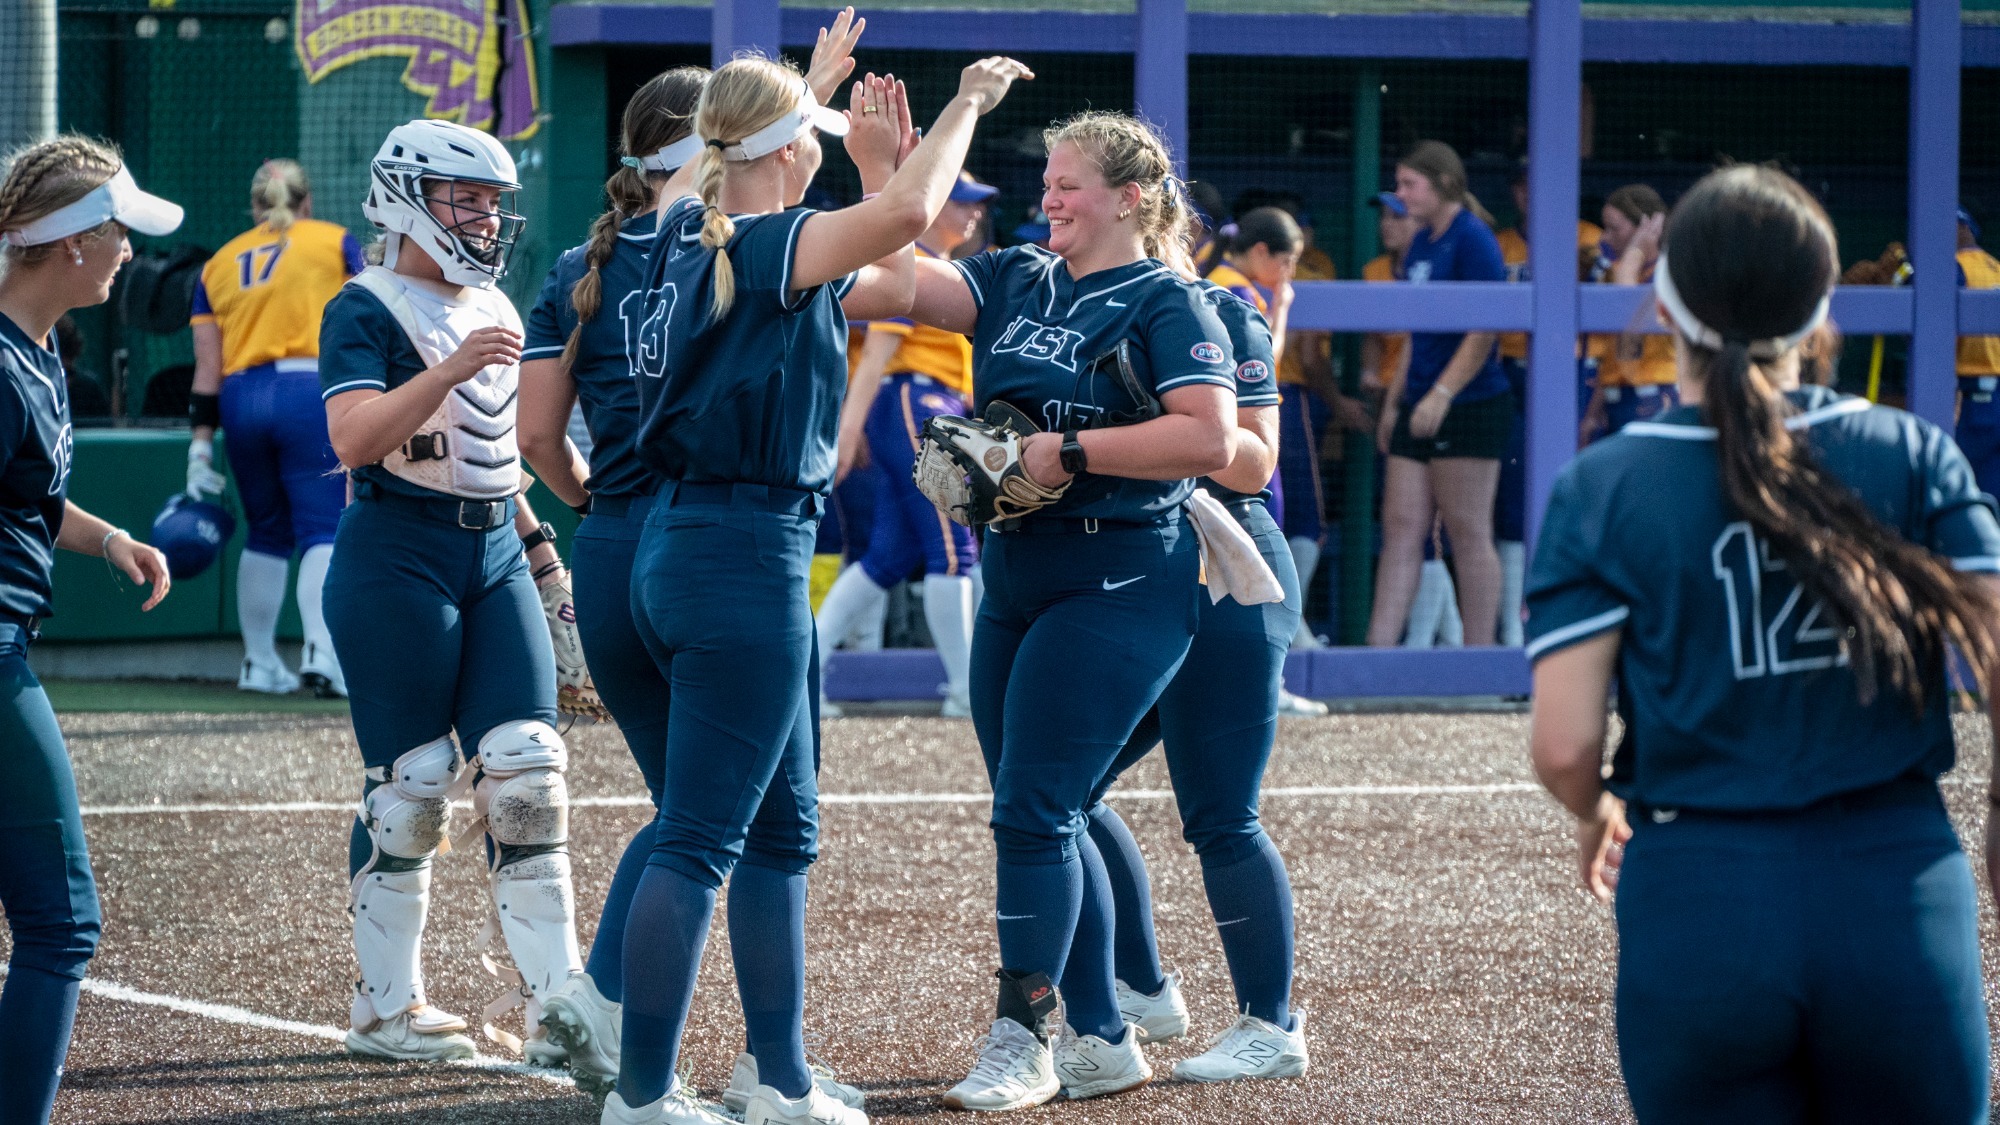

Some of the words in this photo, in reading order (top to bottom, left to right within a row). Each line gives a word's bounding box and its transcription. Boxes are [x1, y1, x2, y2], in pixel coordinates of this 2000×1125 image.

[234, 239, 291, 291] 17
[991, 315, 1086, 373] USI
[1197, 346, 1220, 359] OVC
[1243, 366, 1264, 377] OVC
[1712, 520, 1850, 681] 12
